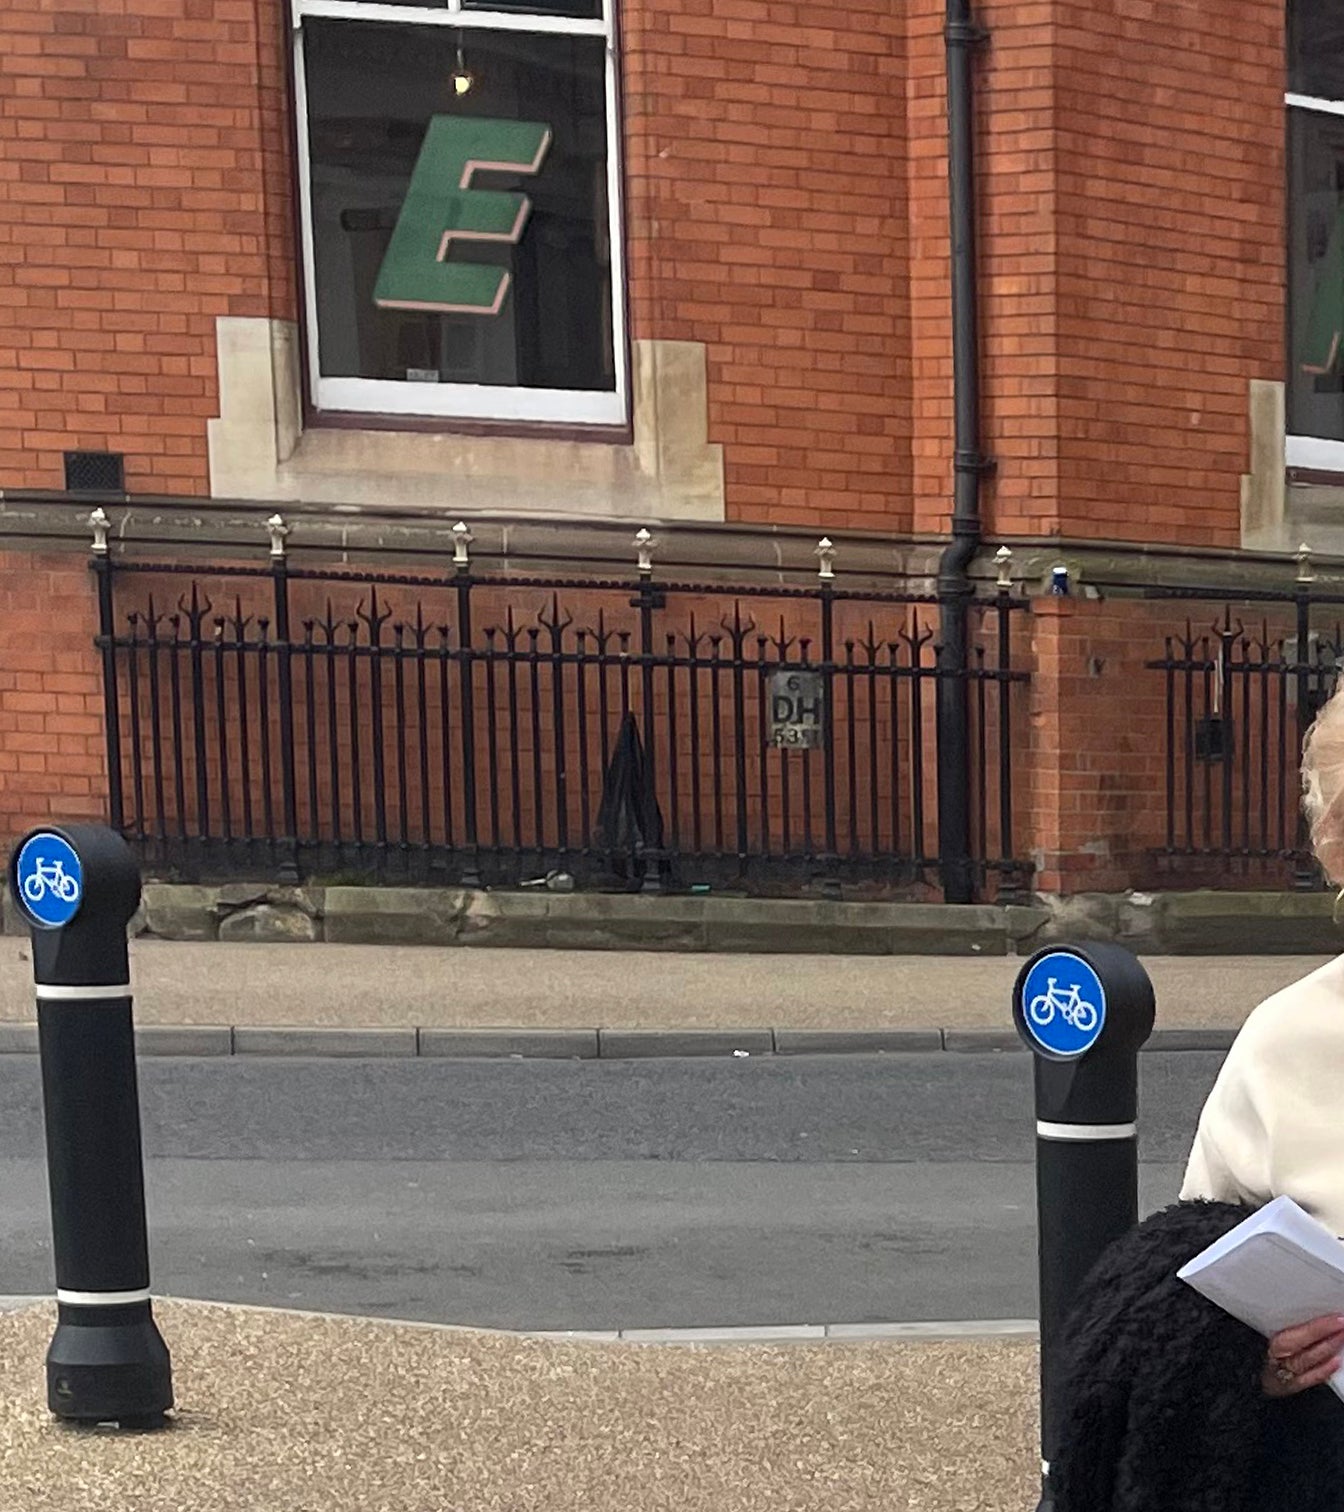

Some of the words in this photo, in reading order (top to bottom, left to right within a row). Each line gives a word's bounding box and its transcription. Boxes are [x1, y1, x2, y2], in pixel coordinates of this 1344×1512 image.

[373, 113, 551, 314] E
[787, 675, 801, 691] 6
[773, 696, 820, 724] DH
